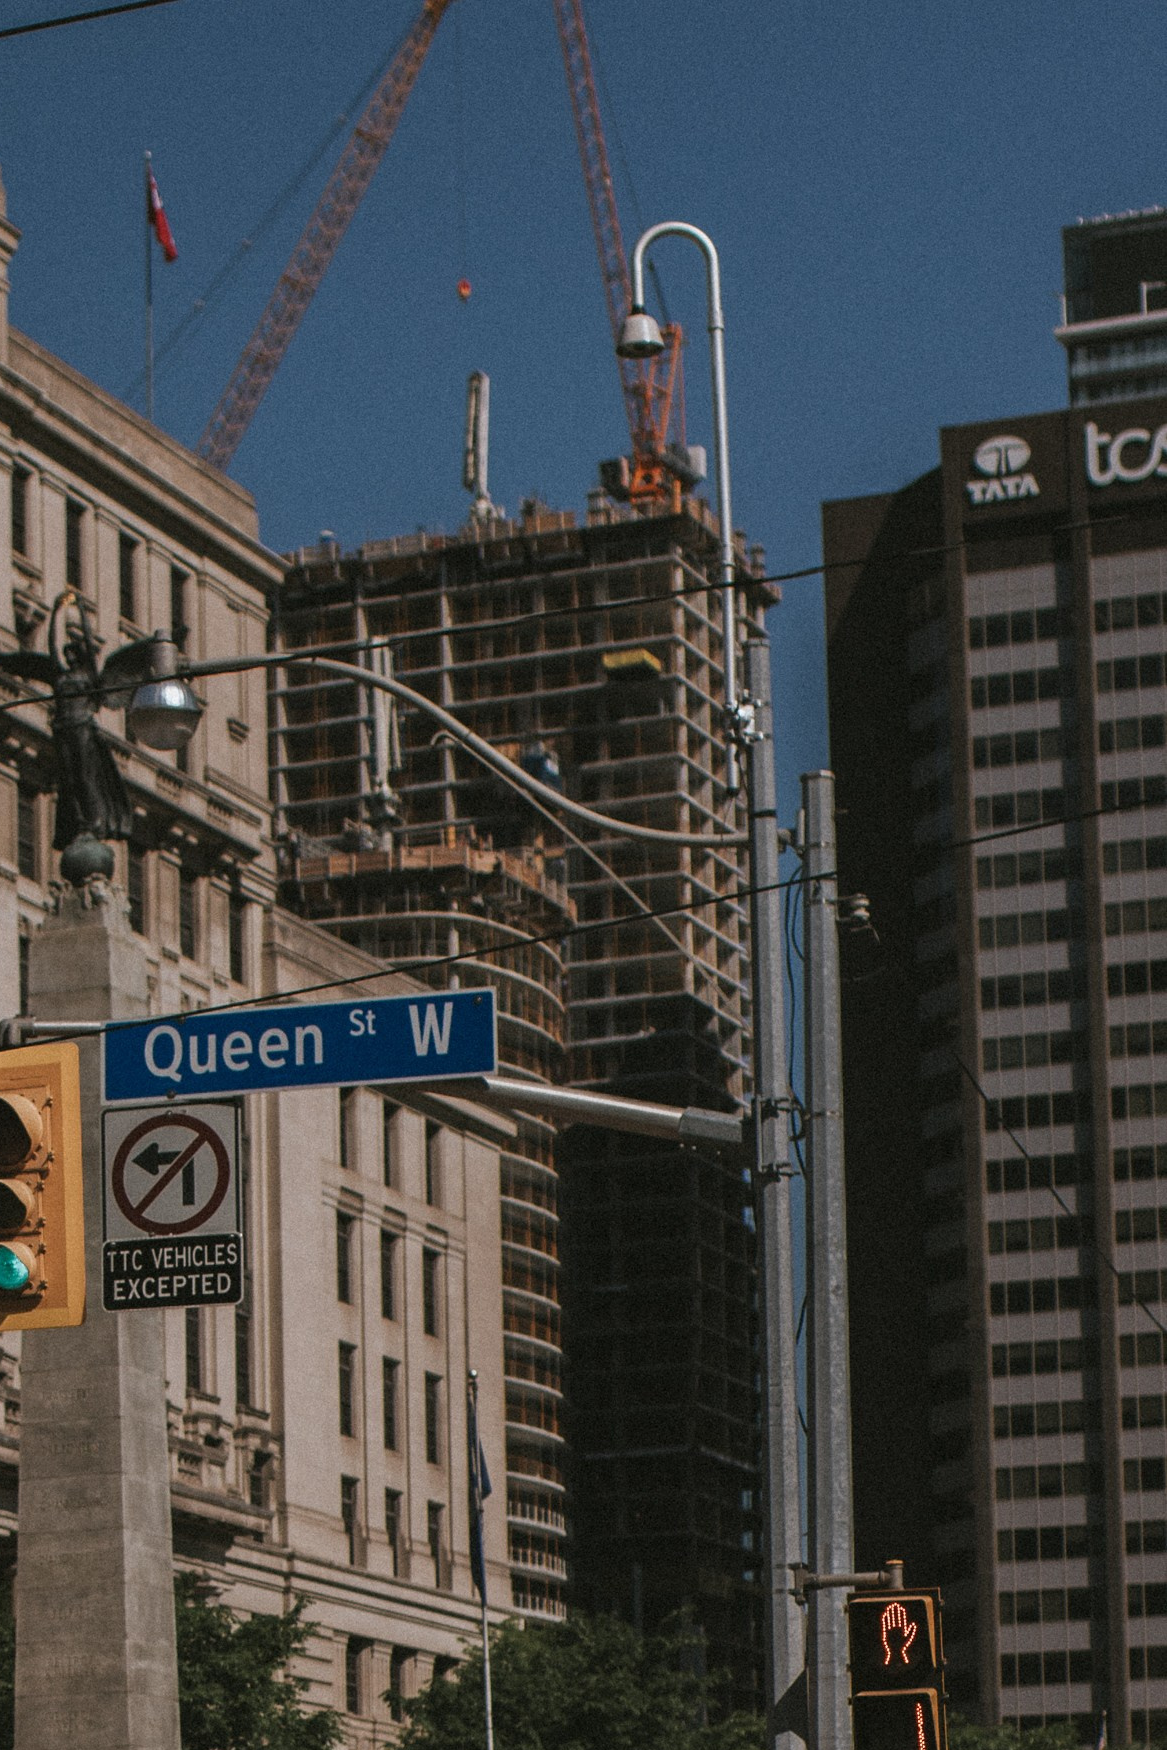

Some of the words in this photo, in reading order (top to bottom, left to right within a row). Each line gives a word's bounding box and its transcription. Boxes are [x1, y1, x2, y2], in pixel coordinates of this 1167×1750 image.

[967, 473, 1039, 503] TATA
[144, 1024, 324, 1082] Queen
[349, 1009, 376, 1036] St
[408, 1002, 453, 1056] W
[107, 1249, 142, 1272] TTC
[151, 1243, 237, 1269] VEHICLES
[113, 1272, 231, 1300] EXCEPTED
